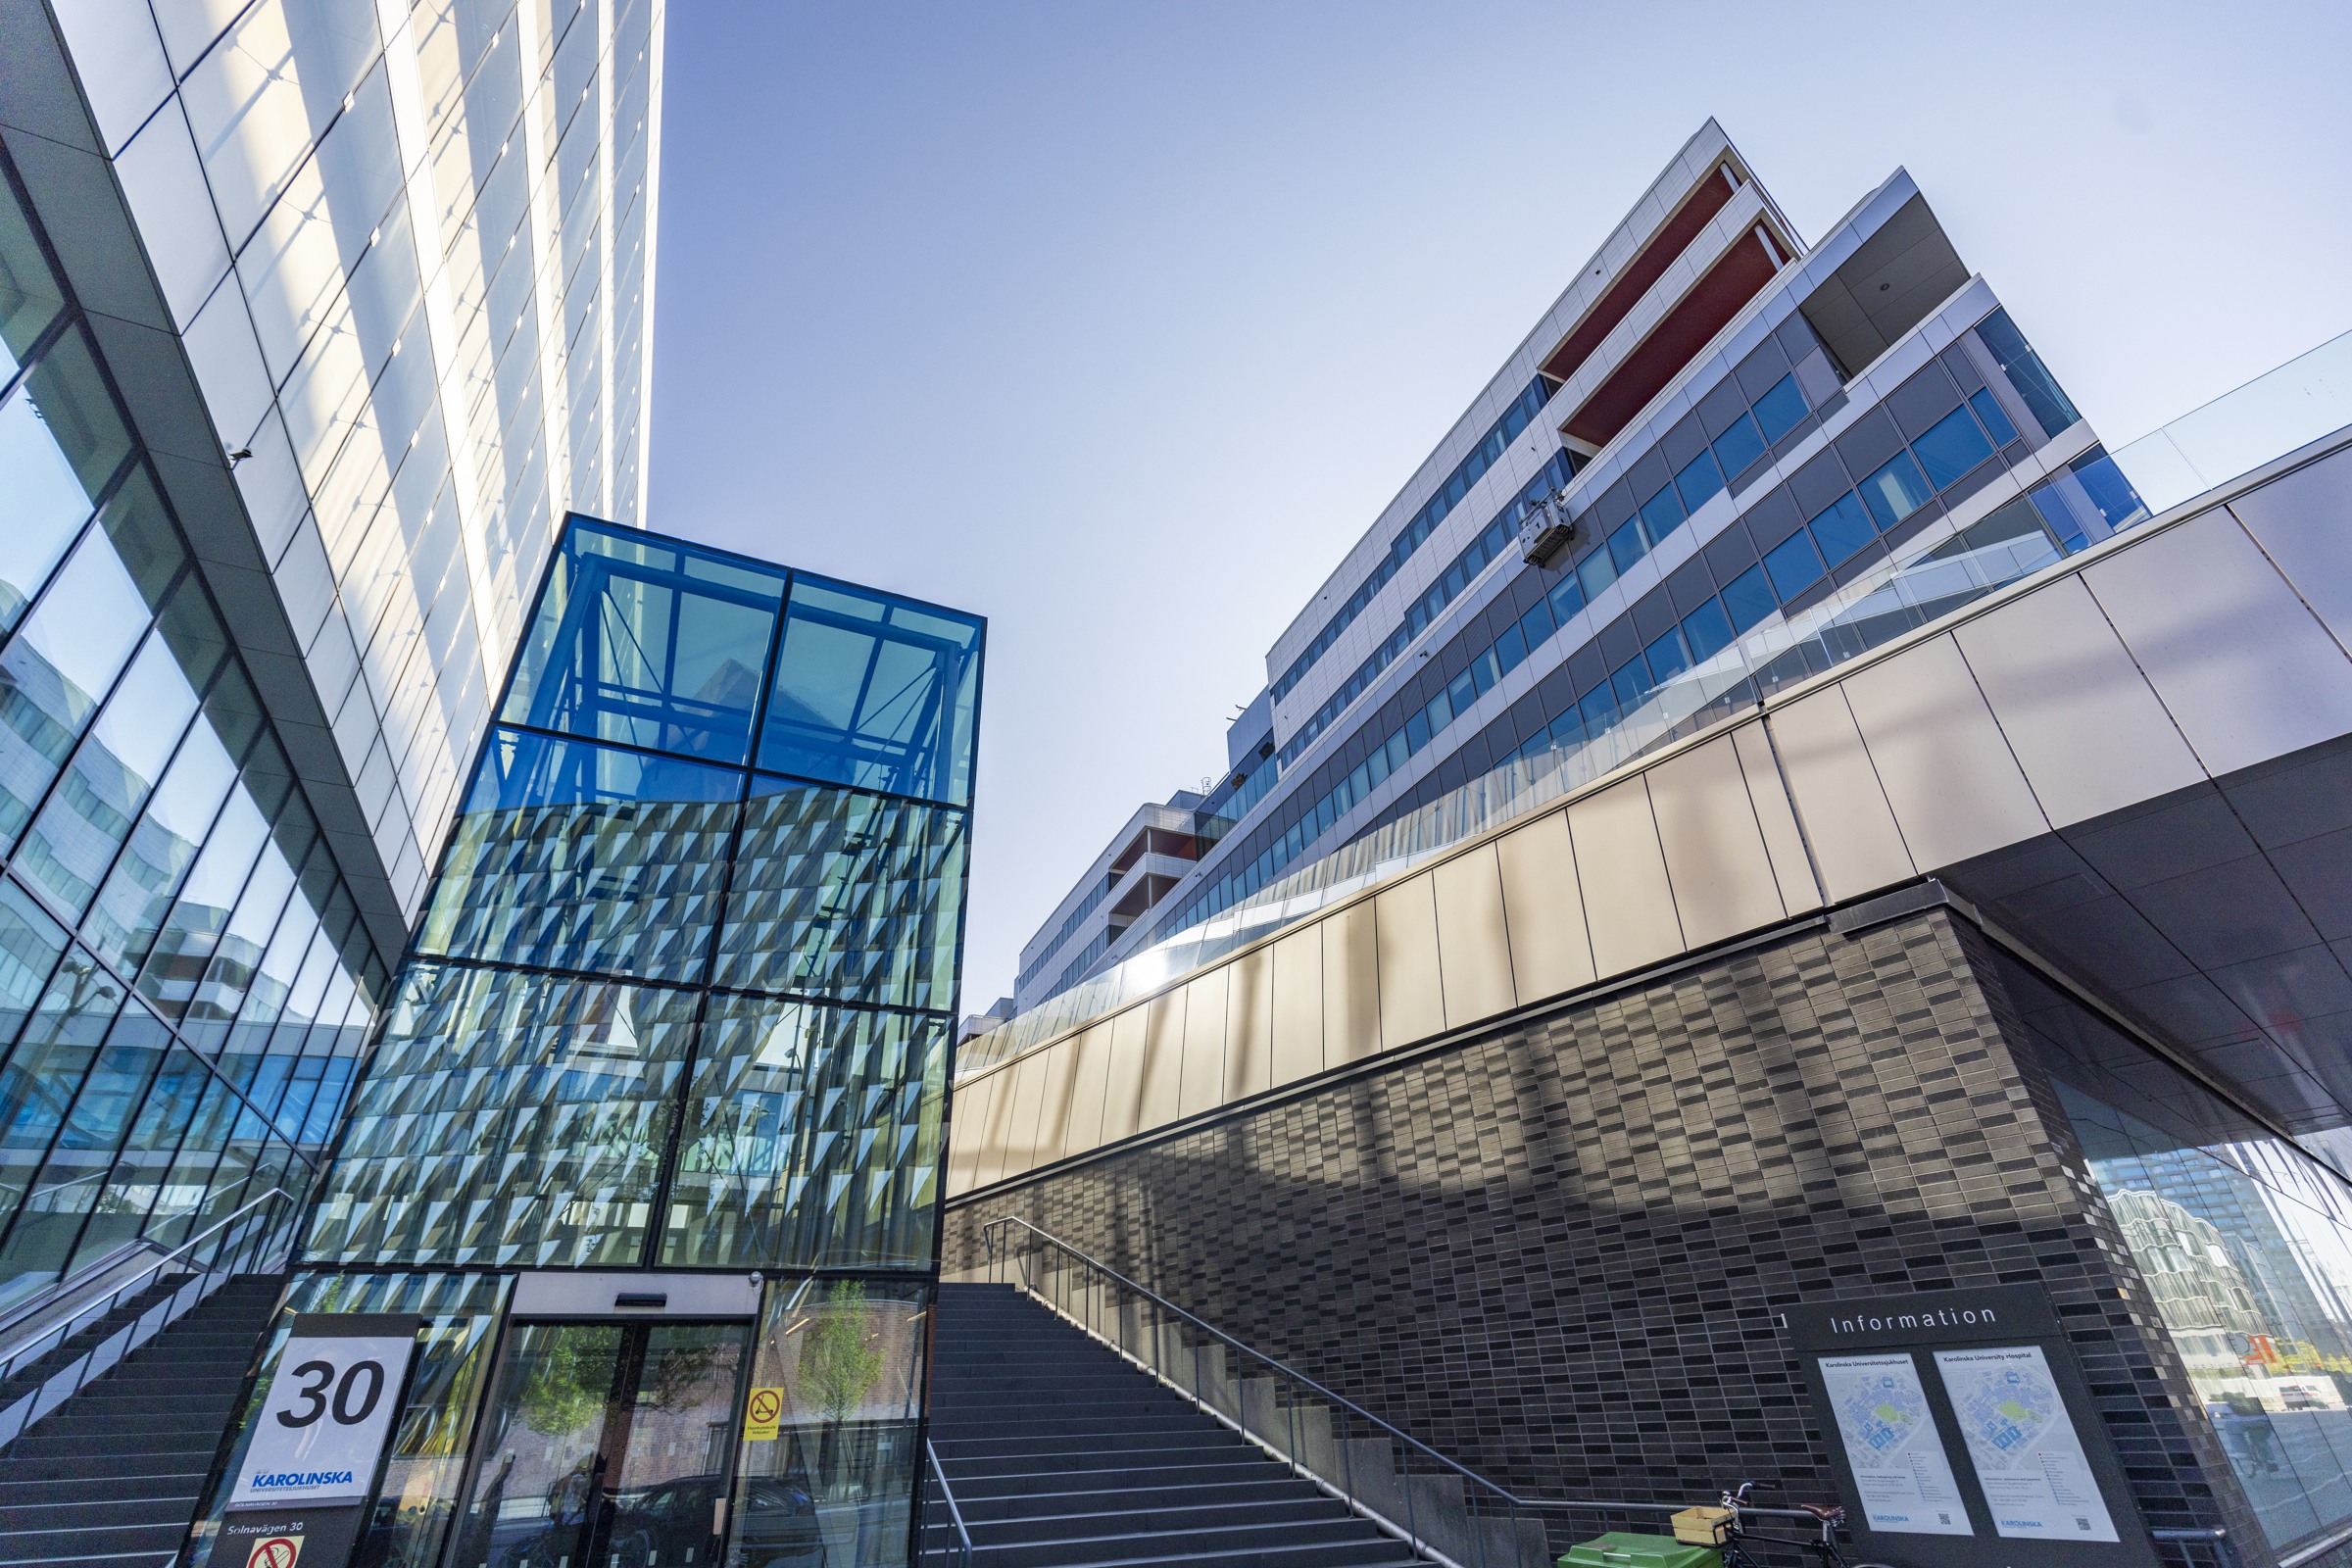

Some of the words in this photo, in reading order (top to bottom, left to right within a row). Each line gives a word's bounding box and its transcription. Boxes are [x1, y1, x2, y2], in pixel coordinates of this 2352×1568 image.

[1831, 1307, 1996, 1334] Information
[276, 1360, 384, 1428] 30
[252, 1471, 353, 1488] KAROLINSKA
[250, 1485, 320, 1494] UNIVERSITETSSJUKHUSET
[226, 1524, 287, 1536] Solnavägen
[289, 1522, 304, 1531] 30
